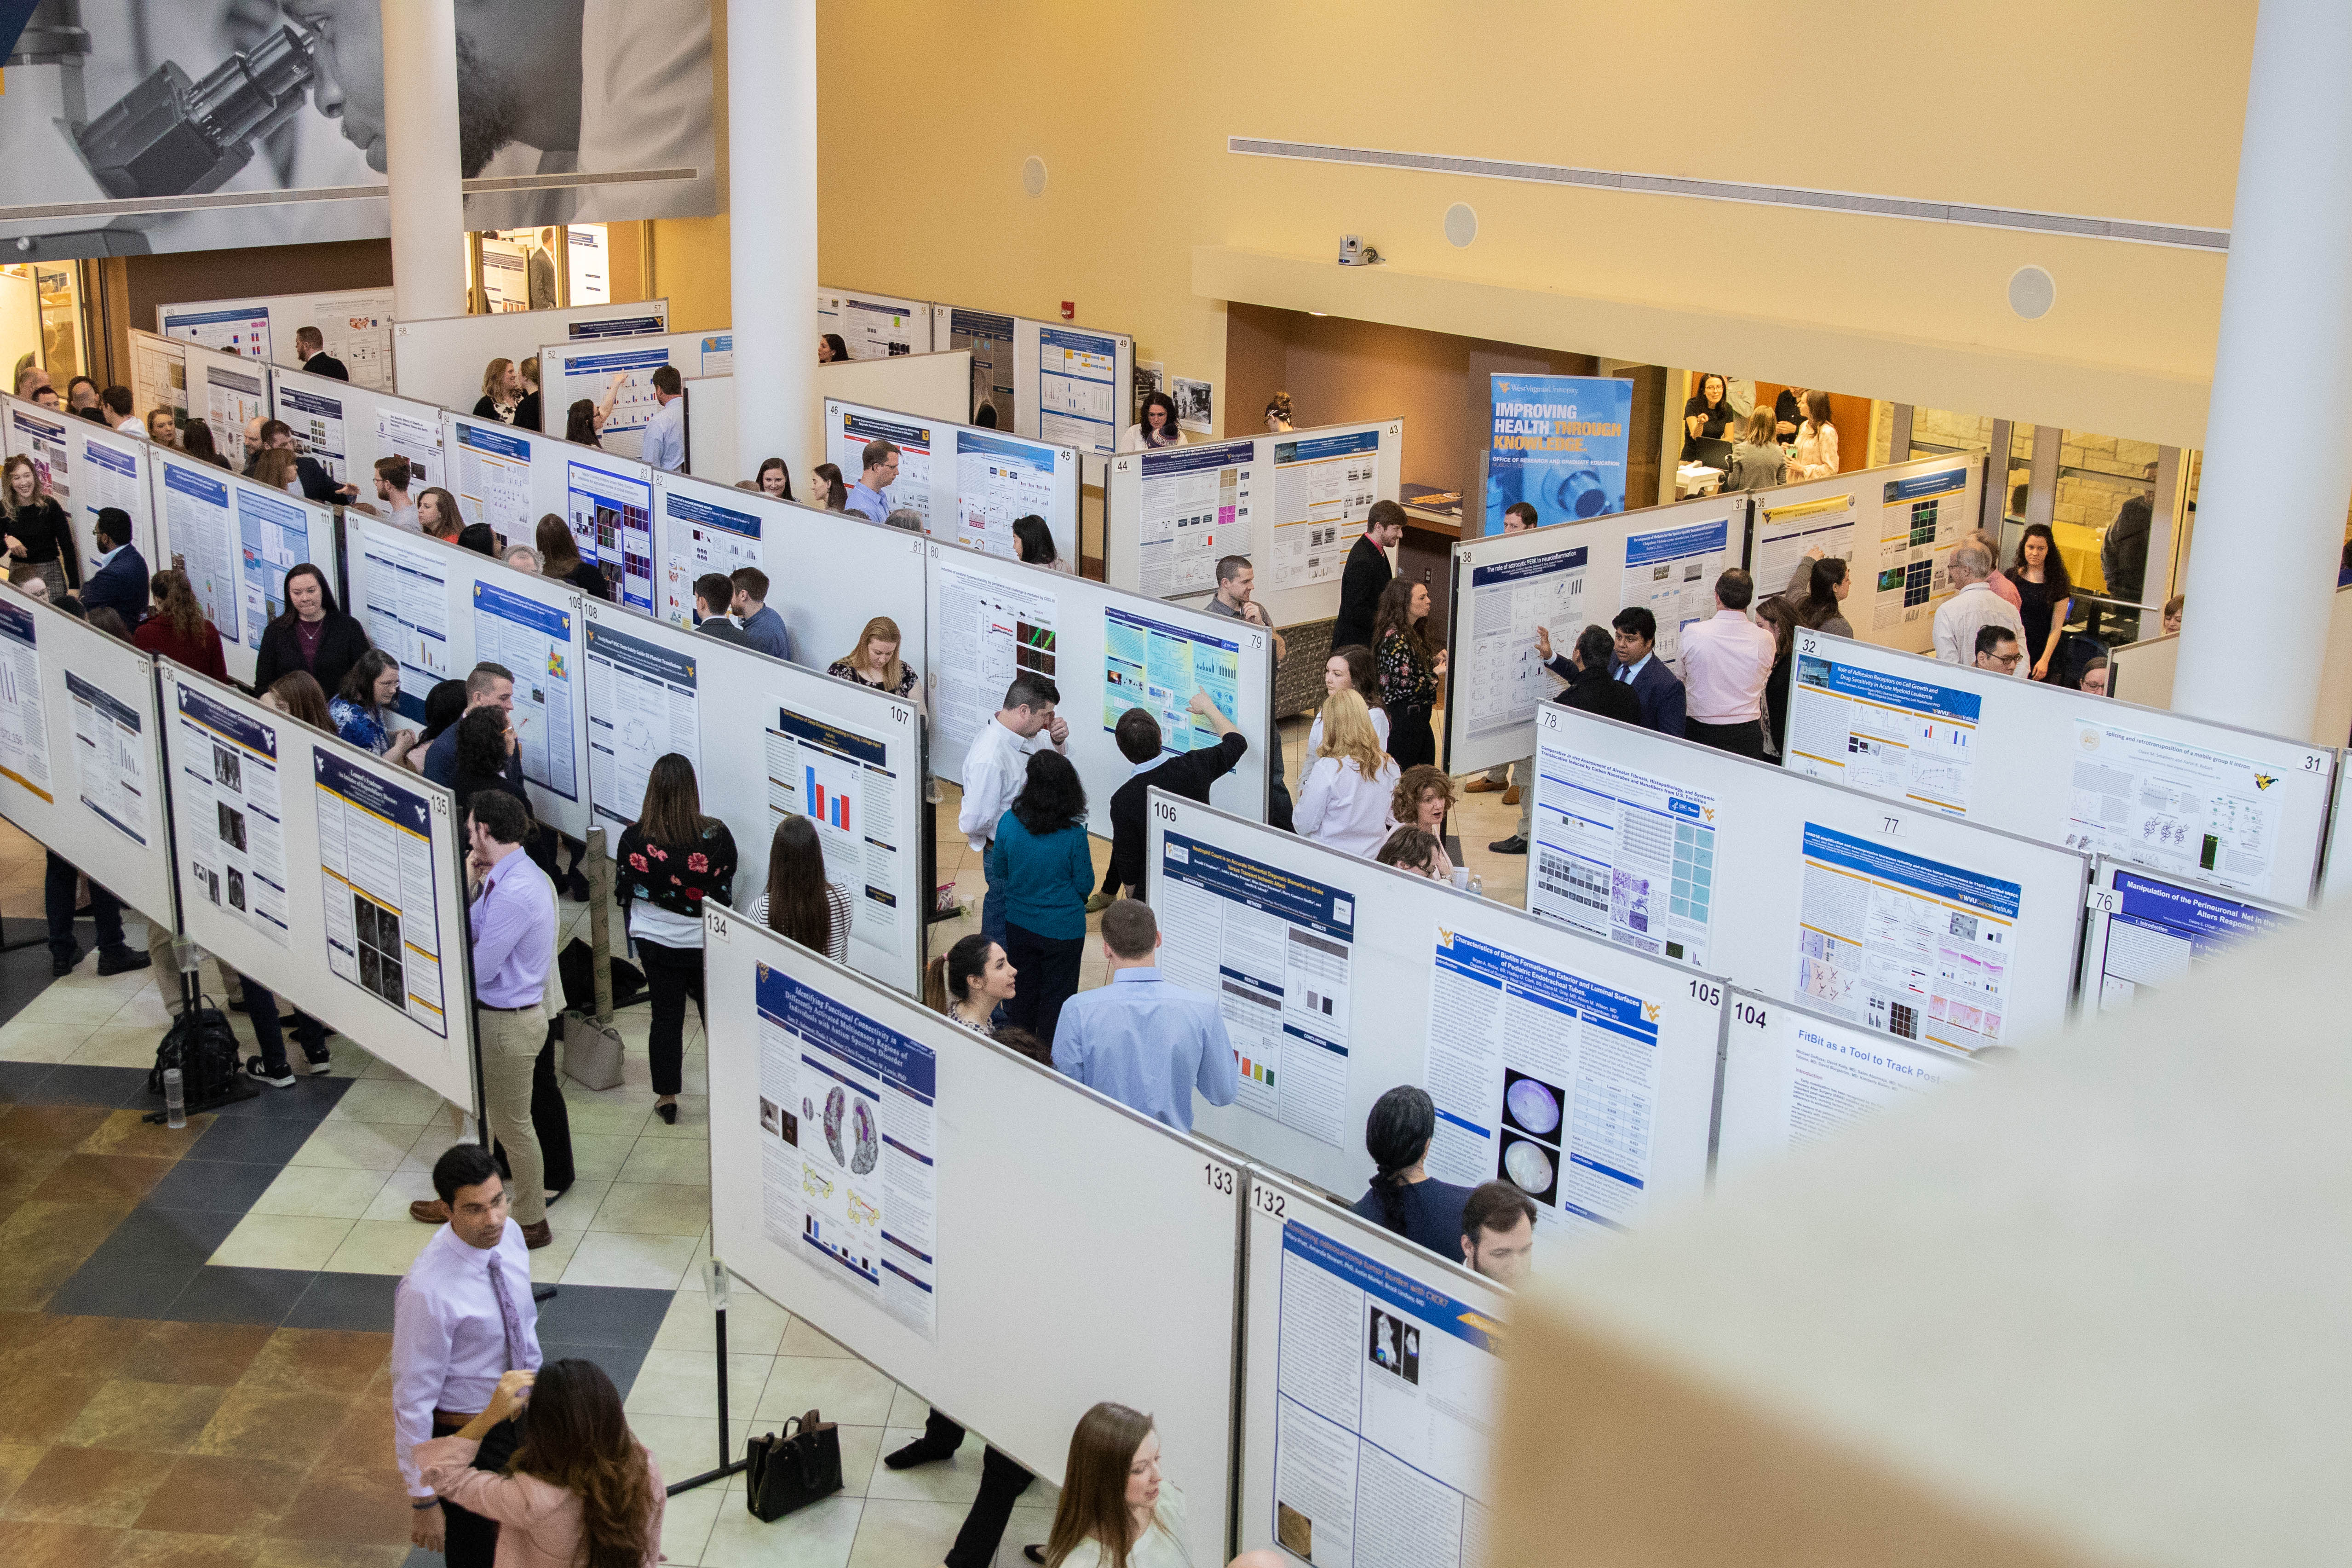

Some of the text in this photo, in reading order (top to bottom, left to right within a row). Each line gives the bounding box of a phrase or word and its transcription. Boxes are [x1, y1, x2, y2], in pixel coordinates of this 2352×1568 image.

[275, 369, 280, 377] 86
[1495, 402, 1577, 419] IMPROVING
[1390, 425, 1398, 434] 43
[1495, 419, 1622, 437] HEALTH THROUGH
[1494, 435, 1587, 451] KNOWLEDGE.
[1061, 451, 1070, 460] 45
[1972, 455, 1978, 464] 35
[1118, 461, 1127, 470] 44
[640, 469, 647, 479] 83
[656, 475, 662, 486] 82
[1736, 499, 1742, 509] 37
[1758, 498, 1765, 507] 36
[349, 517, 358, 530] 110
[914, 541, 921, 552] 81
[931, 546, 938, 558] 80
[1463, 552, 1471, 562] 38
[1508, 560, 1527, 569] astrocytic
[1541, 551, 1577, 563] neuroinflammation
[569, 597, 581, 609] 109
[585, 603, 597, 619] 108
[1252, 635, 1262, 648] 79
[1803, 639, 1815, 653] 32
[138, 661, 148, 673] 137
[162, 668, 173, 682] 136
[1852, 670, 1874, 679] Adhesion
[1874, 674, 1895, 684] Receptors
[1911, 683, 1928, 692] Growth
[1840, 674, 1851, 683] Drug
[1852, 677, 1874, 688] Sensitivity
[1892, 686, 1911, 695] Myeloid
[1911, 690, 1933, 700] Leukemia
[891, 706, 908, 724] 107
[1545, 712, 1557, 728] 78
[2105, 730, 2125, 741] Splicing
[2136, 739, 2183, 754] retrotransposition
[2194, 752, 2212, 761] mobile
[2212, 757, 2229, 766] group
[2234, 761, 2250, 770] intron
[2305, 756, 2320, 771] 31
[1541, 745, 1566, 757] Comparative
[1581, 757, 1606, 770] Assessment
[1612, 767, 1630, 776] Alveolar
[1630, 772, 1649, 782] Fibrosis,
[1650, 778, 1684, 793] Histopathology,
[1694, 791, 1715, 802] Systemic
[1541, 750, 1568, 763] Translocation
[1568, 758, 1585, 768] Induced
[1591, 765, 1606, 774] Carbon
[1607, 770, 1630, 781] Nanotubes
[1639, 780, 1663, 792] Nanofibers
[1685, 793, 1707, 804] Facilities
[431, 795, 447, 814] 135
[1155, 802, 1176, 821] 106
[1885, 817, 1898, 833] 77
[1183, 877, 1204, 888] BACKGROUND
[1247, 900, 1262, 908] METHODS
[1963, 895, 1977, 904] WVU
[1993, 905, 2013, 915] Institute
[2097, 893, 2112, 910] 76
[2126, 880, 2170, 899] Manipulation
[2180, 896, 2192, 905] the
[2192, 898, 2238, 917] Perineuronal
[2241, 912, 2254, 922] Net
[708, 914, 726, 936] 134
[1311, 923, 1326, 932] RESULTS
[2140, 920, 2168, 932] Introduction
[2197, 909, 2254, 932] Alters Response
[1436, 959, 1458, 970] Introduction
[1455, 935, 1493, 955] Characteristics
[1500, 952, 1519, 964] Biofilm
[1520, 959, 1547, 975] Formation
[1556, 971, 1578, 986] Exterior
[1579, 982, 1590, 990] and
[1591, 984, 1614, 999] Luminal
[1614, 993, 1640, 1008] Surfaces
[1507, 963, 1531, 977] Pediatric
[1531, 971, 1568, 989] Endotracheal
[1568, 984, 1587, 996] Tubes.
[1507, 985, 1523, 995] Methods
[1690, 981, 1719, 1005] 105
[1582, 1013, 1597, 1022] Results
[1736, 1003, 1765, 1028] 104
[1799, 1030, 1824, 1046] FitBit
[1827, 1041, 1837, 1051] as
[1850, 1046, 1870, 1061] Tool
[1873, 1056, 1883, 1065] to
[1886, 1058, 1913, 1076] Track
[1795, 1068, 1823, 1080] Introduction
[1570, 1154, 1593, 1166] Conclusion
[1205, 1164, 1232, 1195] 133
[1255, 1187, 1285, 1218] 132
